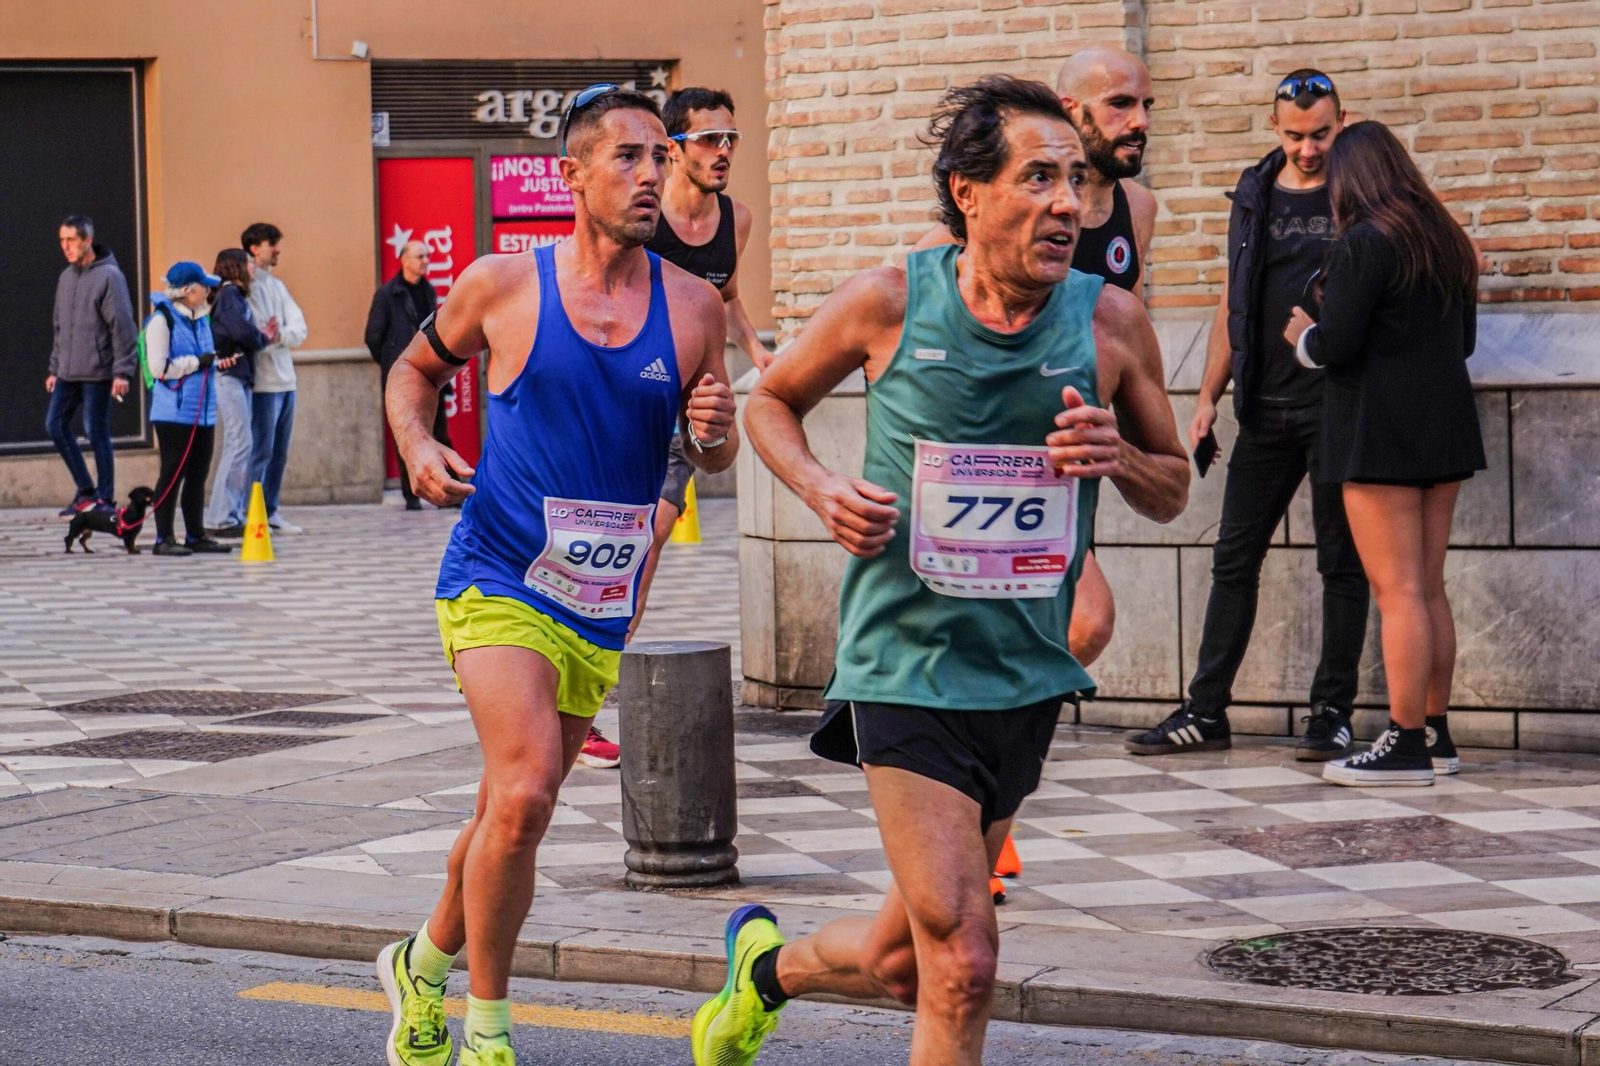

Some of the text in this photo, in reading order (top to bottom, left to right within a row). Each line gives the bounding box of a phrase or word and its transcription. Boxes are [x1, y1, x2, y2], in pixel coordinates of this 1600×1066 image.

[950, 454, 1045, 468] CARRERA
[575, 519, 625, 530] UNIVERSIDAD
[943, 496, 1047, 531] 776
[563, 539, 636, 570] 908
